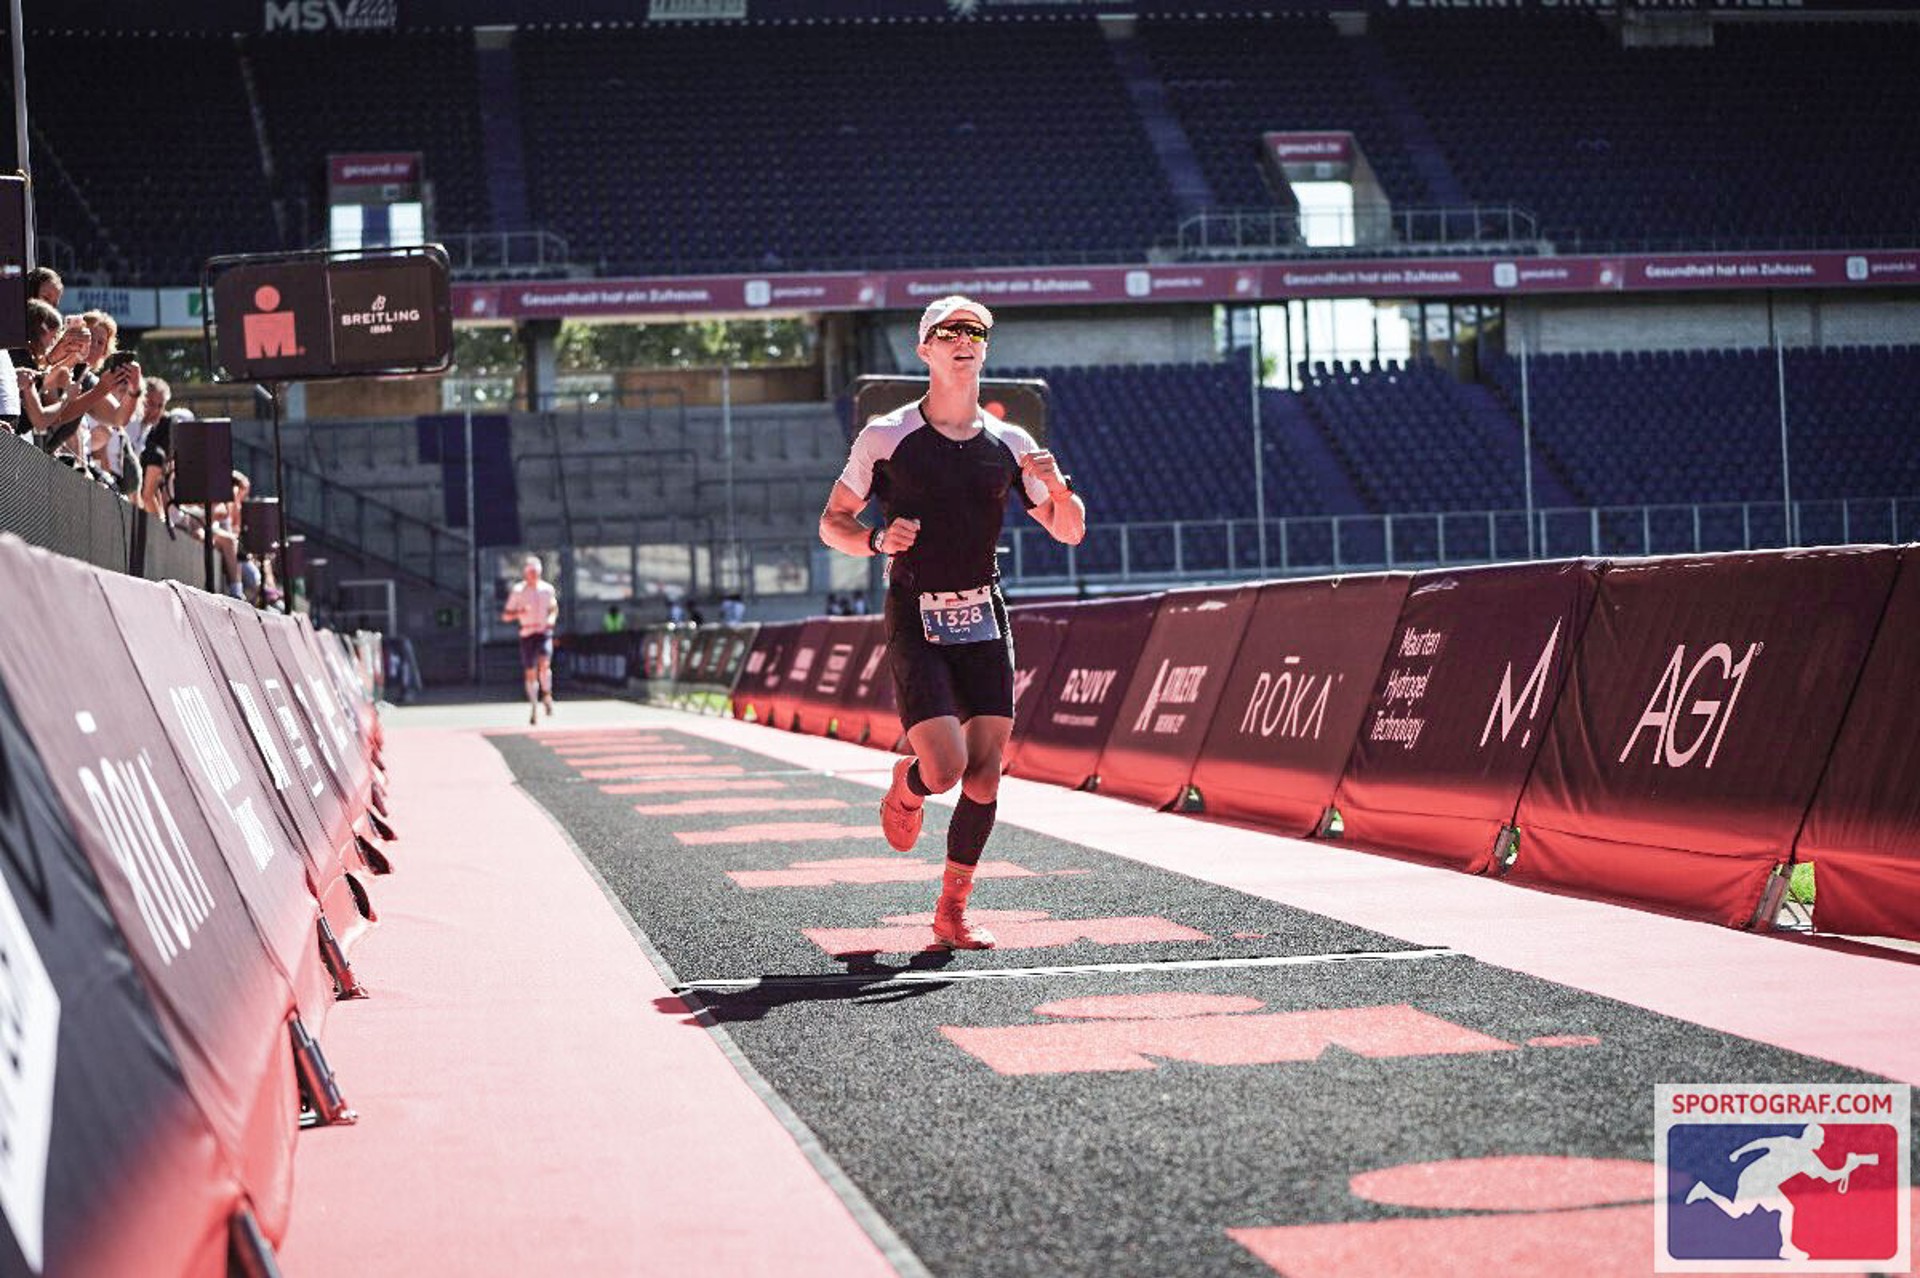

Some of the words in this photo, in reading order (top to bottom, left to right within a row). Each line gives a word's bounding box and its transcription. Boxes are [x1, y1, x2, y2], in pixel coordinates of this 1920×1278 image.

[341, 309, 420, 326] BREITLING
[933, 606, 983, 627] 1328
[1398, 626, 1441, 657] Maurten
[1383, 665, 1433, 707] Hydrogel
[1618, 642, 1757, 769] AG1
[1370, 709, 1425, 749] Technology
